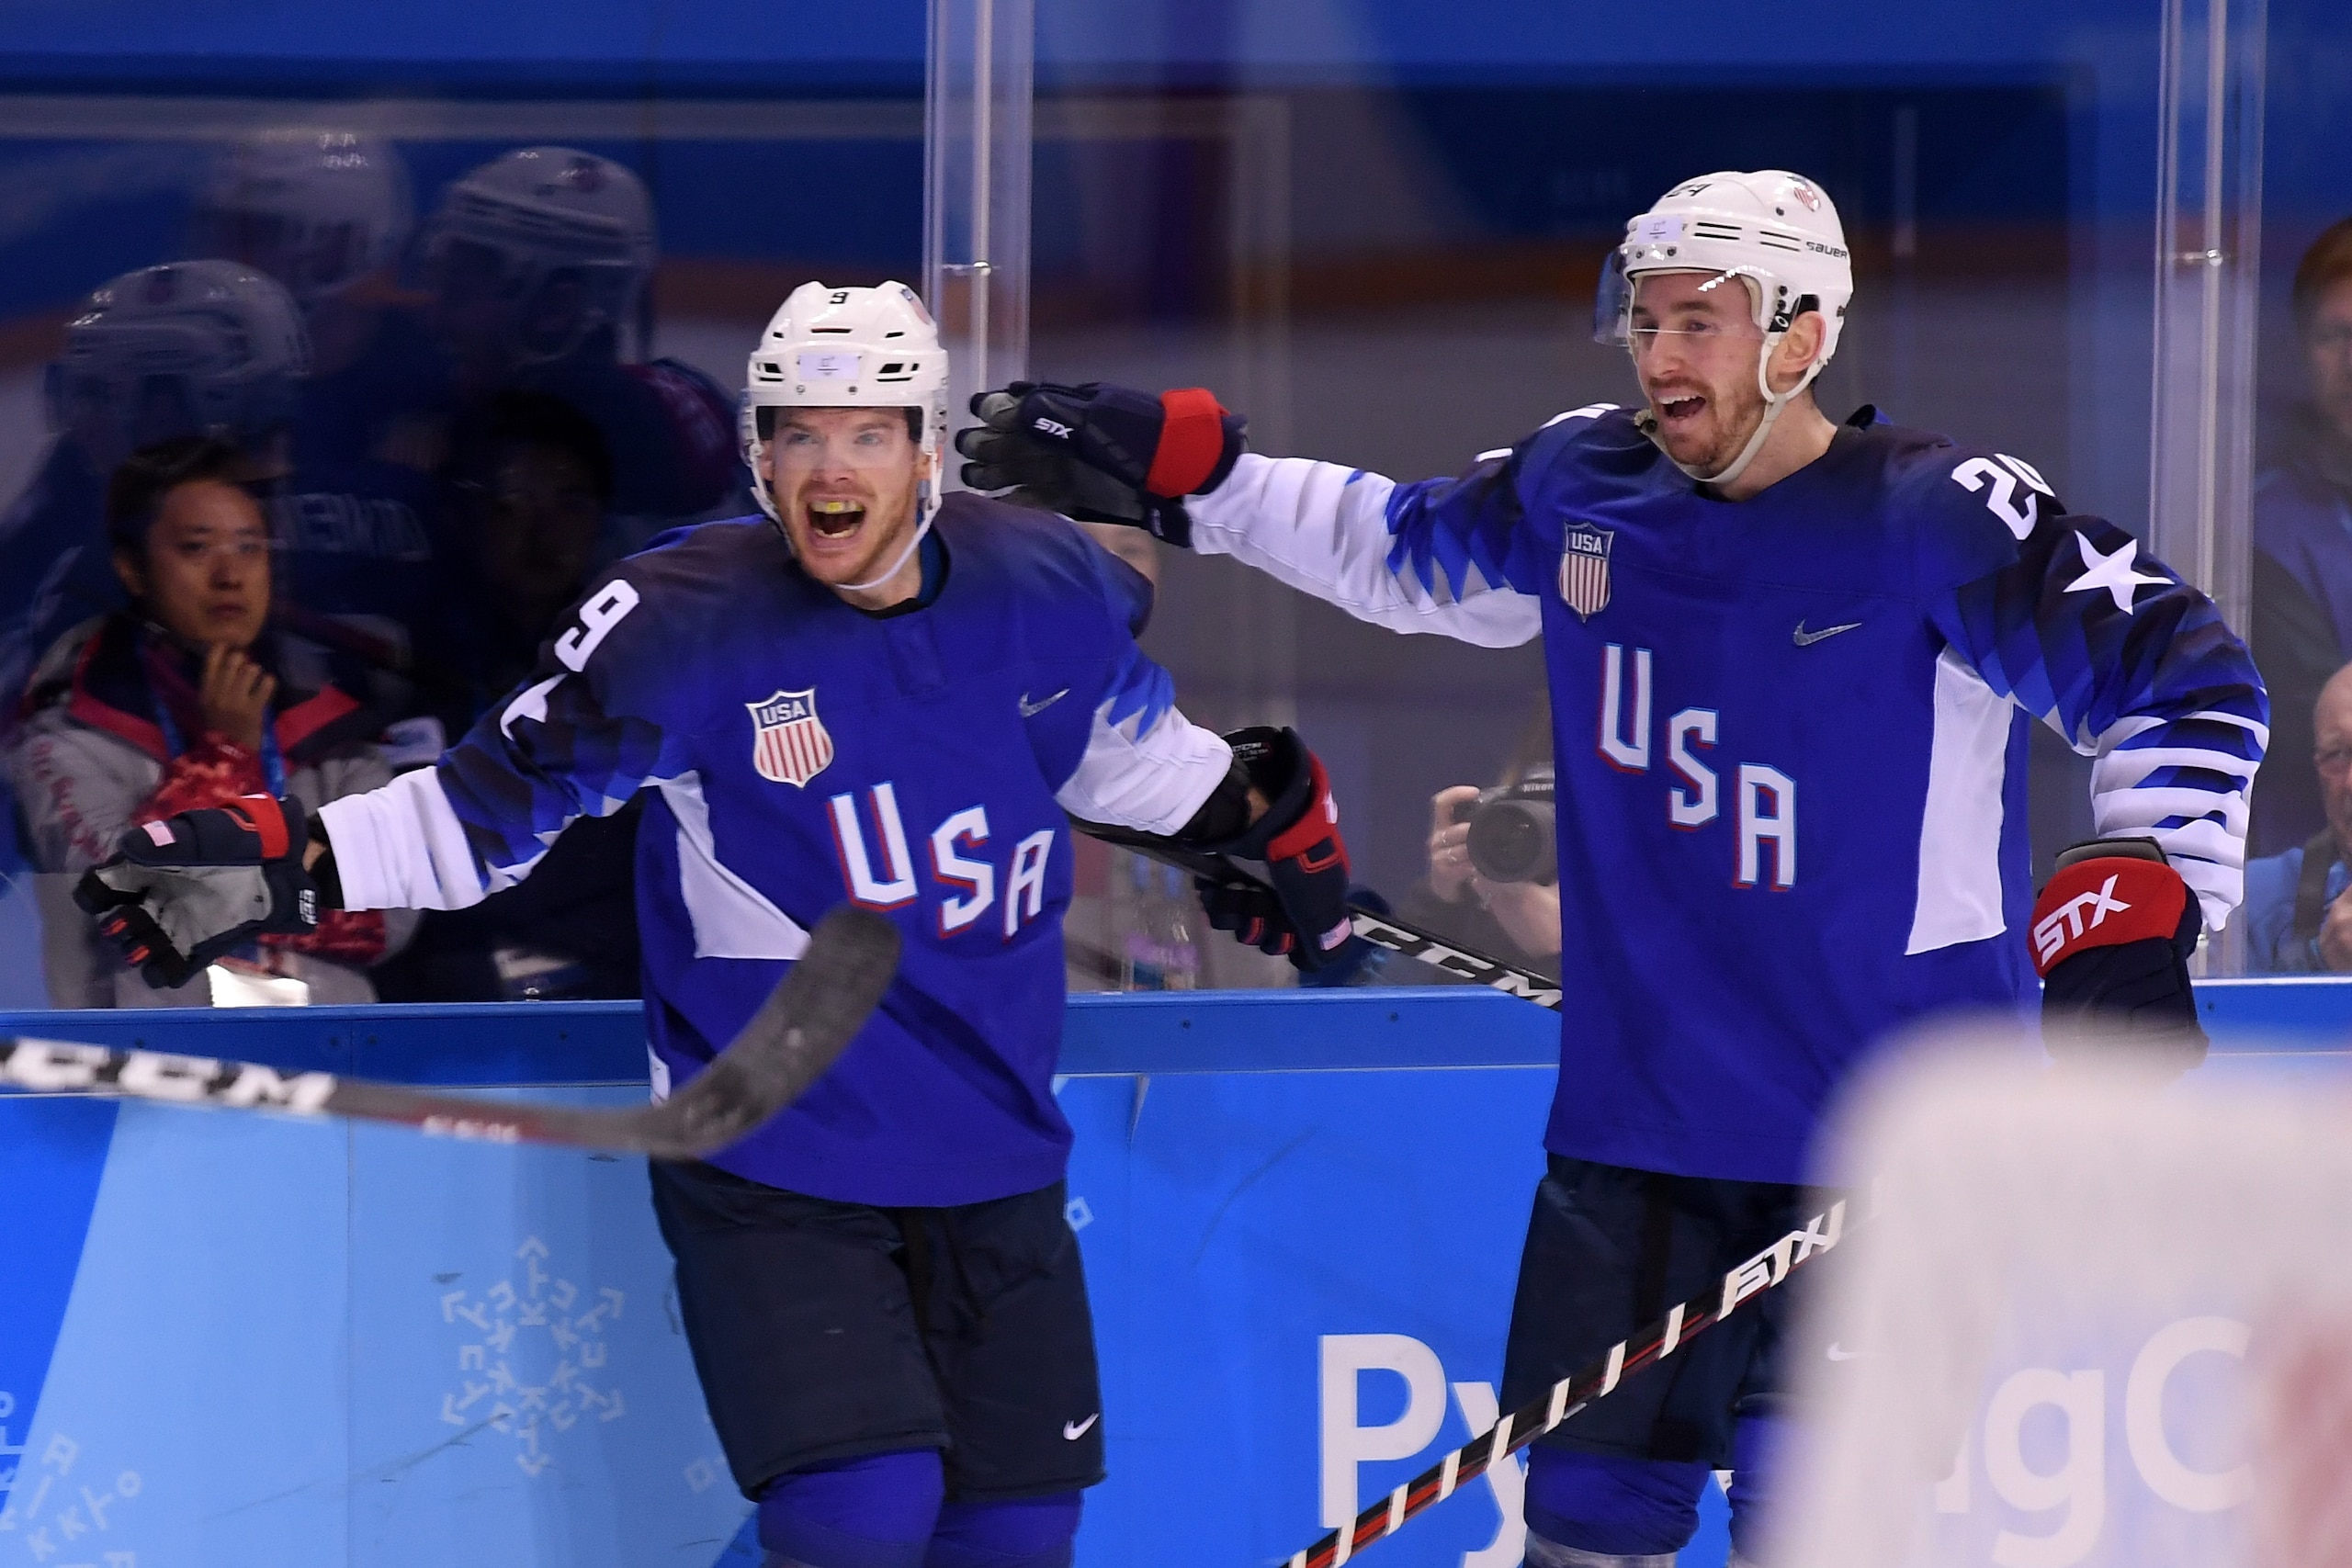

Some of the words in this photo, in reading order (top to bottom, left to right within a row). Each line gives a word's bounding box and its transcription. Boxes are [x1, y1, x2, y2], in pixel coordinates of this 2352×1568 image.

[830, 292, 849, 304] 9
[1033, 417, 1075, 439] STX
[1571, 532, 1603, 554] USA
[554, 578, 640, 672] 9
[761, 700, 807, 725] USA
[1596, 642, 1798, 893] USA
[826, 781, 1055, 944] USA
[1352, 913, 1562, 1008] CCM
[2033, 874, 2132, 967] STX
[3, 1036, 336, 1116] CCM
[1726, 1213, 1828, 1303] STX
